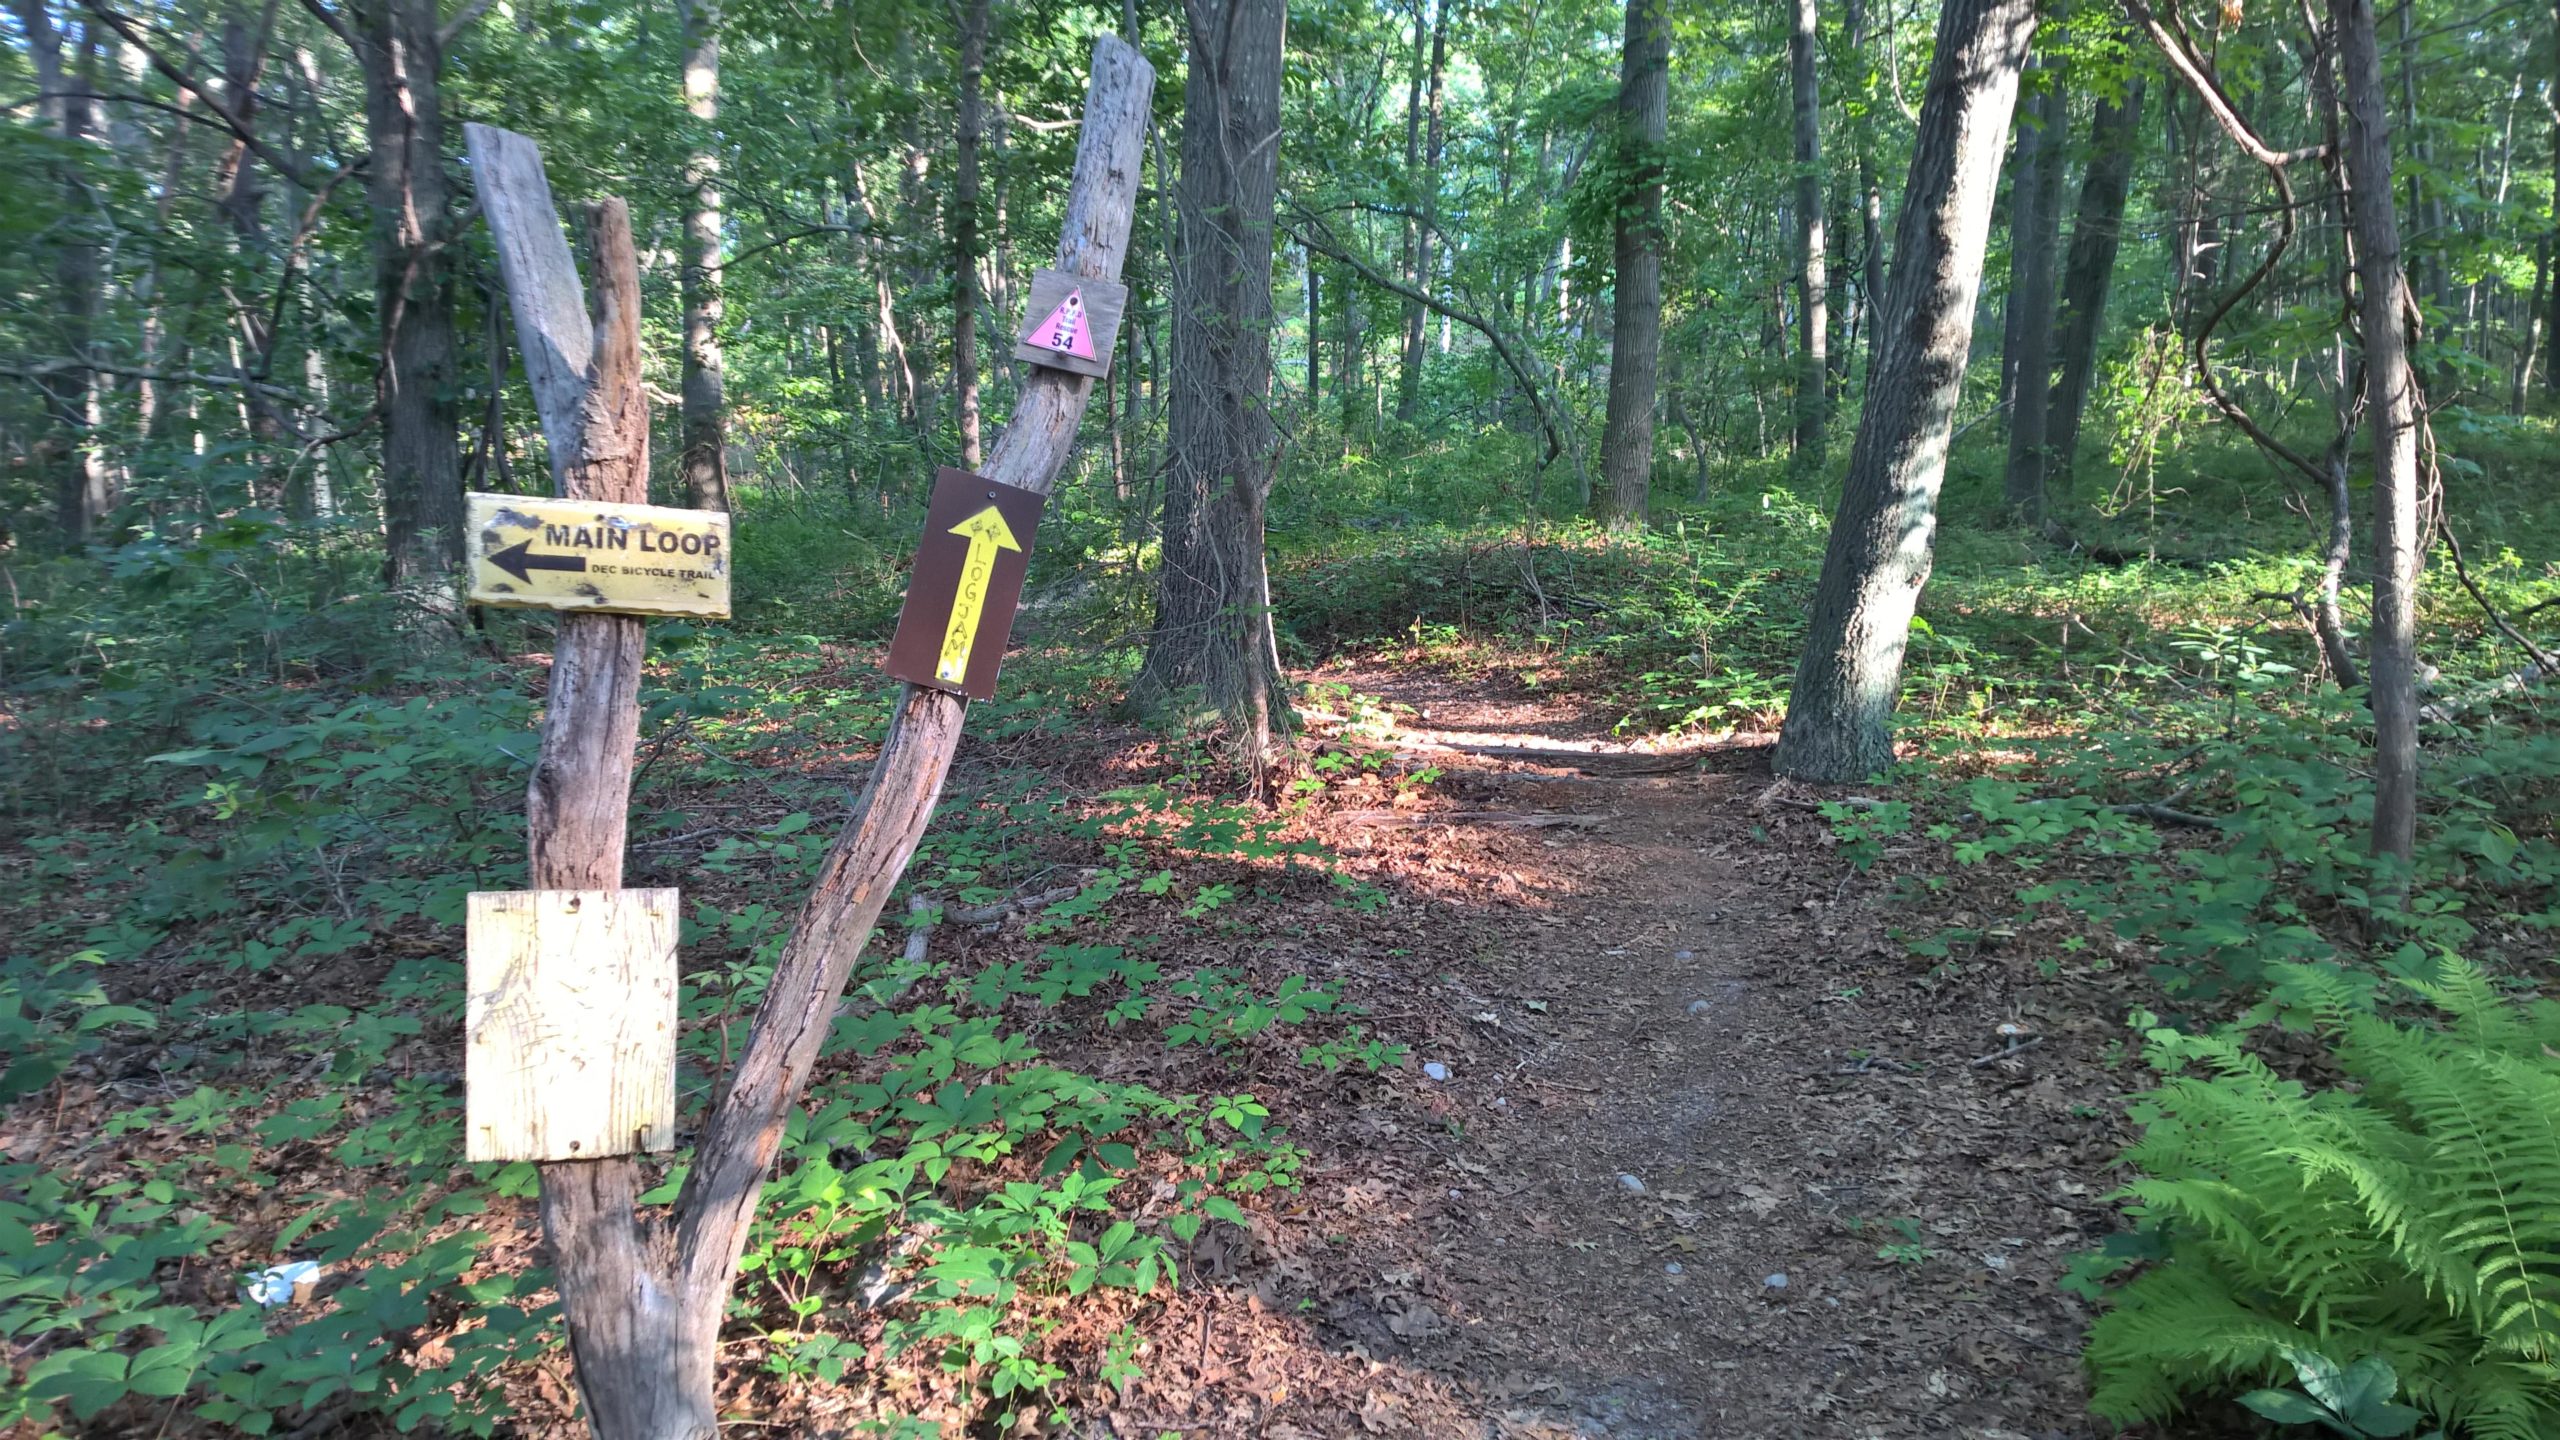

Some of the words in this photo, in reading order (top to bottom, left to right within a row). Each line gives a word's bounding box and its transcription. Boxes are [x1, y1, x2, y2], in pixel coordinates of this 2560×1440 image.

[1056, 322, 1078, 334] Rescue
[1062, 315, 1077, 325] Trail
[1052, 332, 1073, 349] 54
[546, 524, 627, 550] MAIN
[639, 528, 722, 556] LOOP
[592, 564, 617, 575] DEC
[622, 565, 675, 578] BICYCLE
[679, 569, 715, 580] TRAIL
[944, 543, 987, 659] LOGJAM
